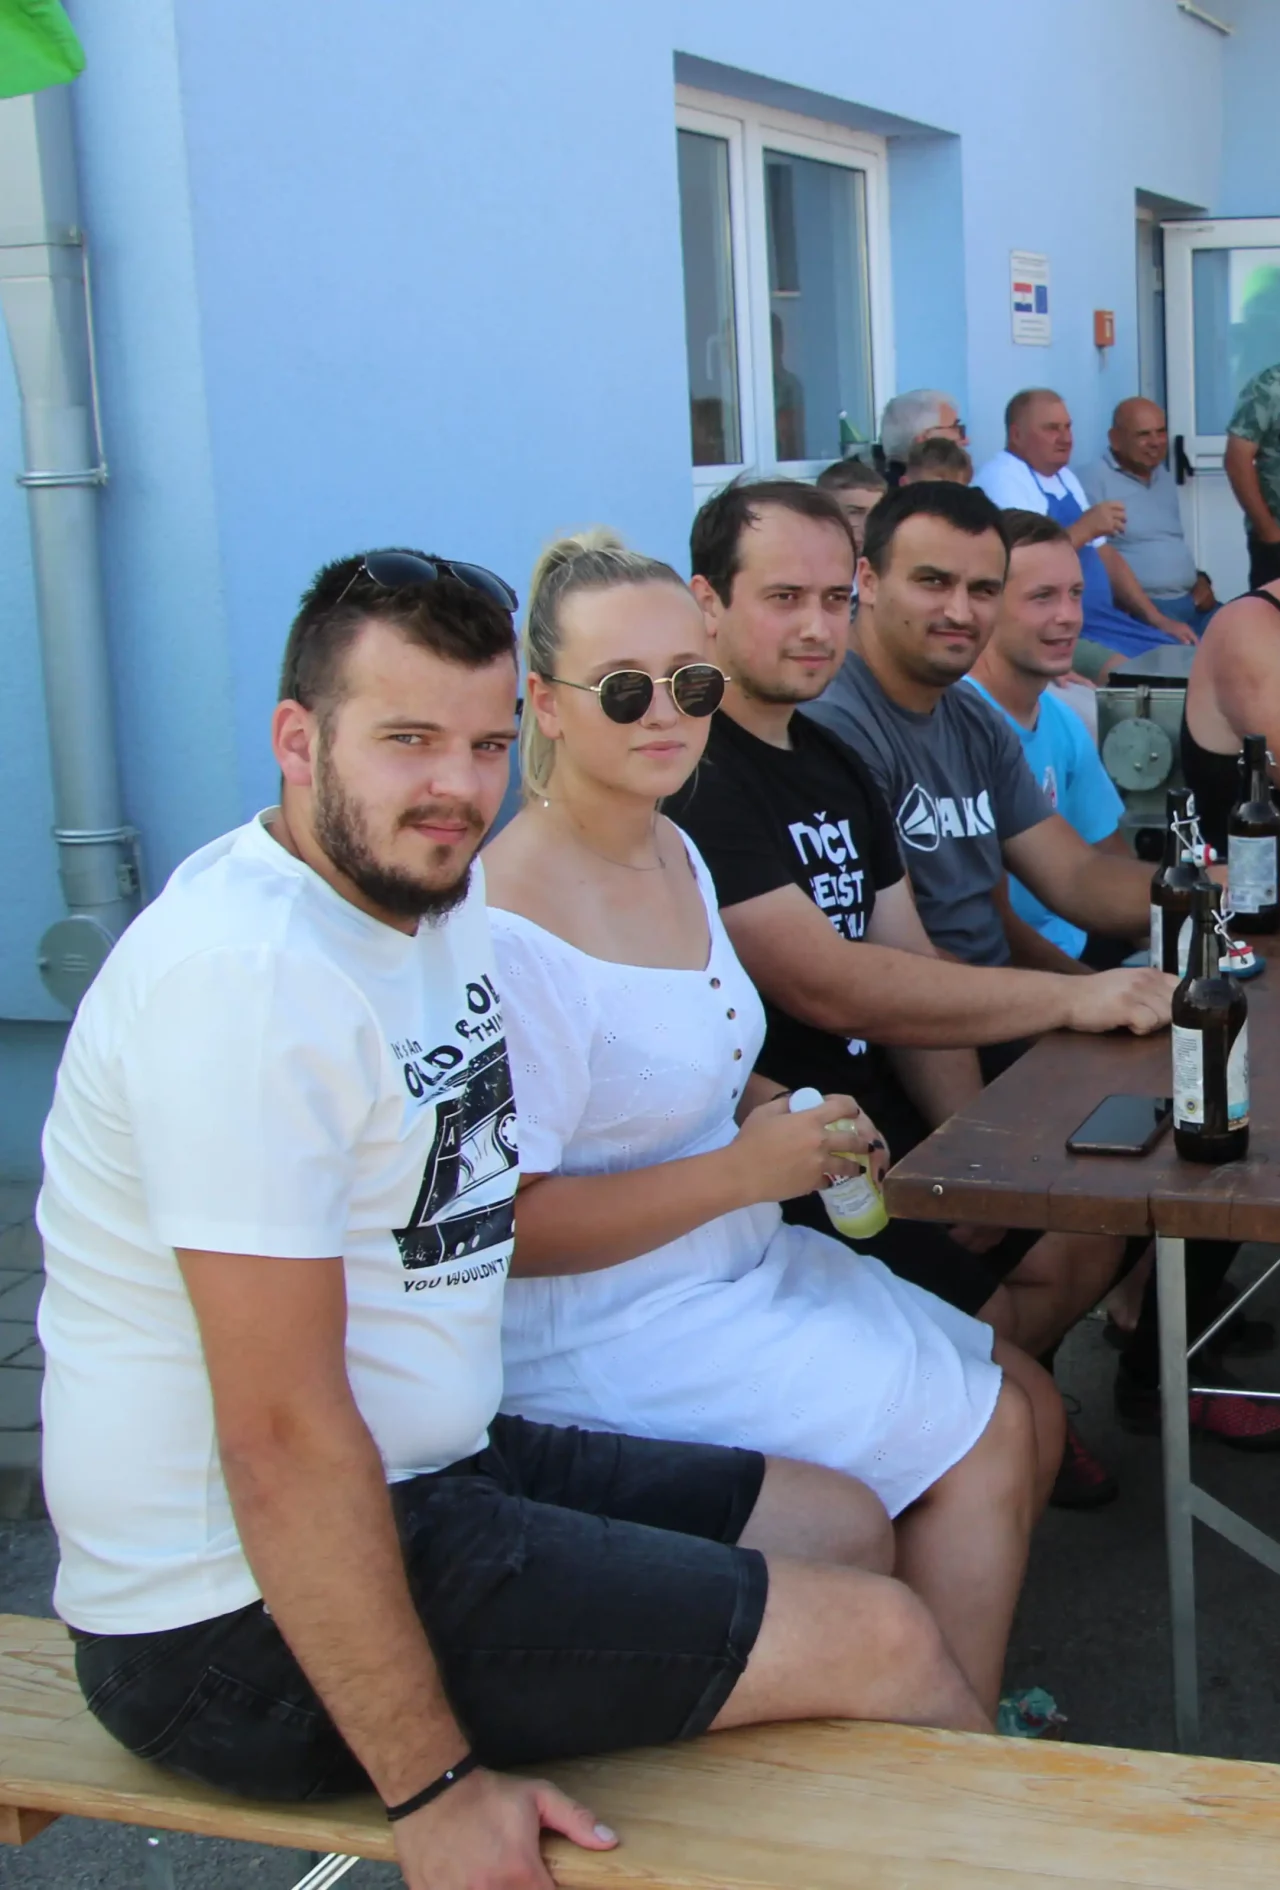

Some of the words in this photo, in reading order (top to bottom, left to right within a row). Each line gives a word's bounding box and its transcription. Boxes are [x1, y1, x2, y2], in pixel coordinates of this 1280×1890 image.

[404, 1044, 464, 1098] OLD
[444, 1126, 456, 1148] A
[403, 1277, 442, 1293] YOU
[446, 1258, 506, 1286] WOULDN'T
